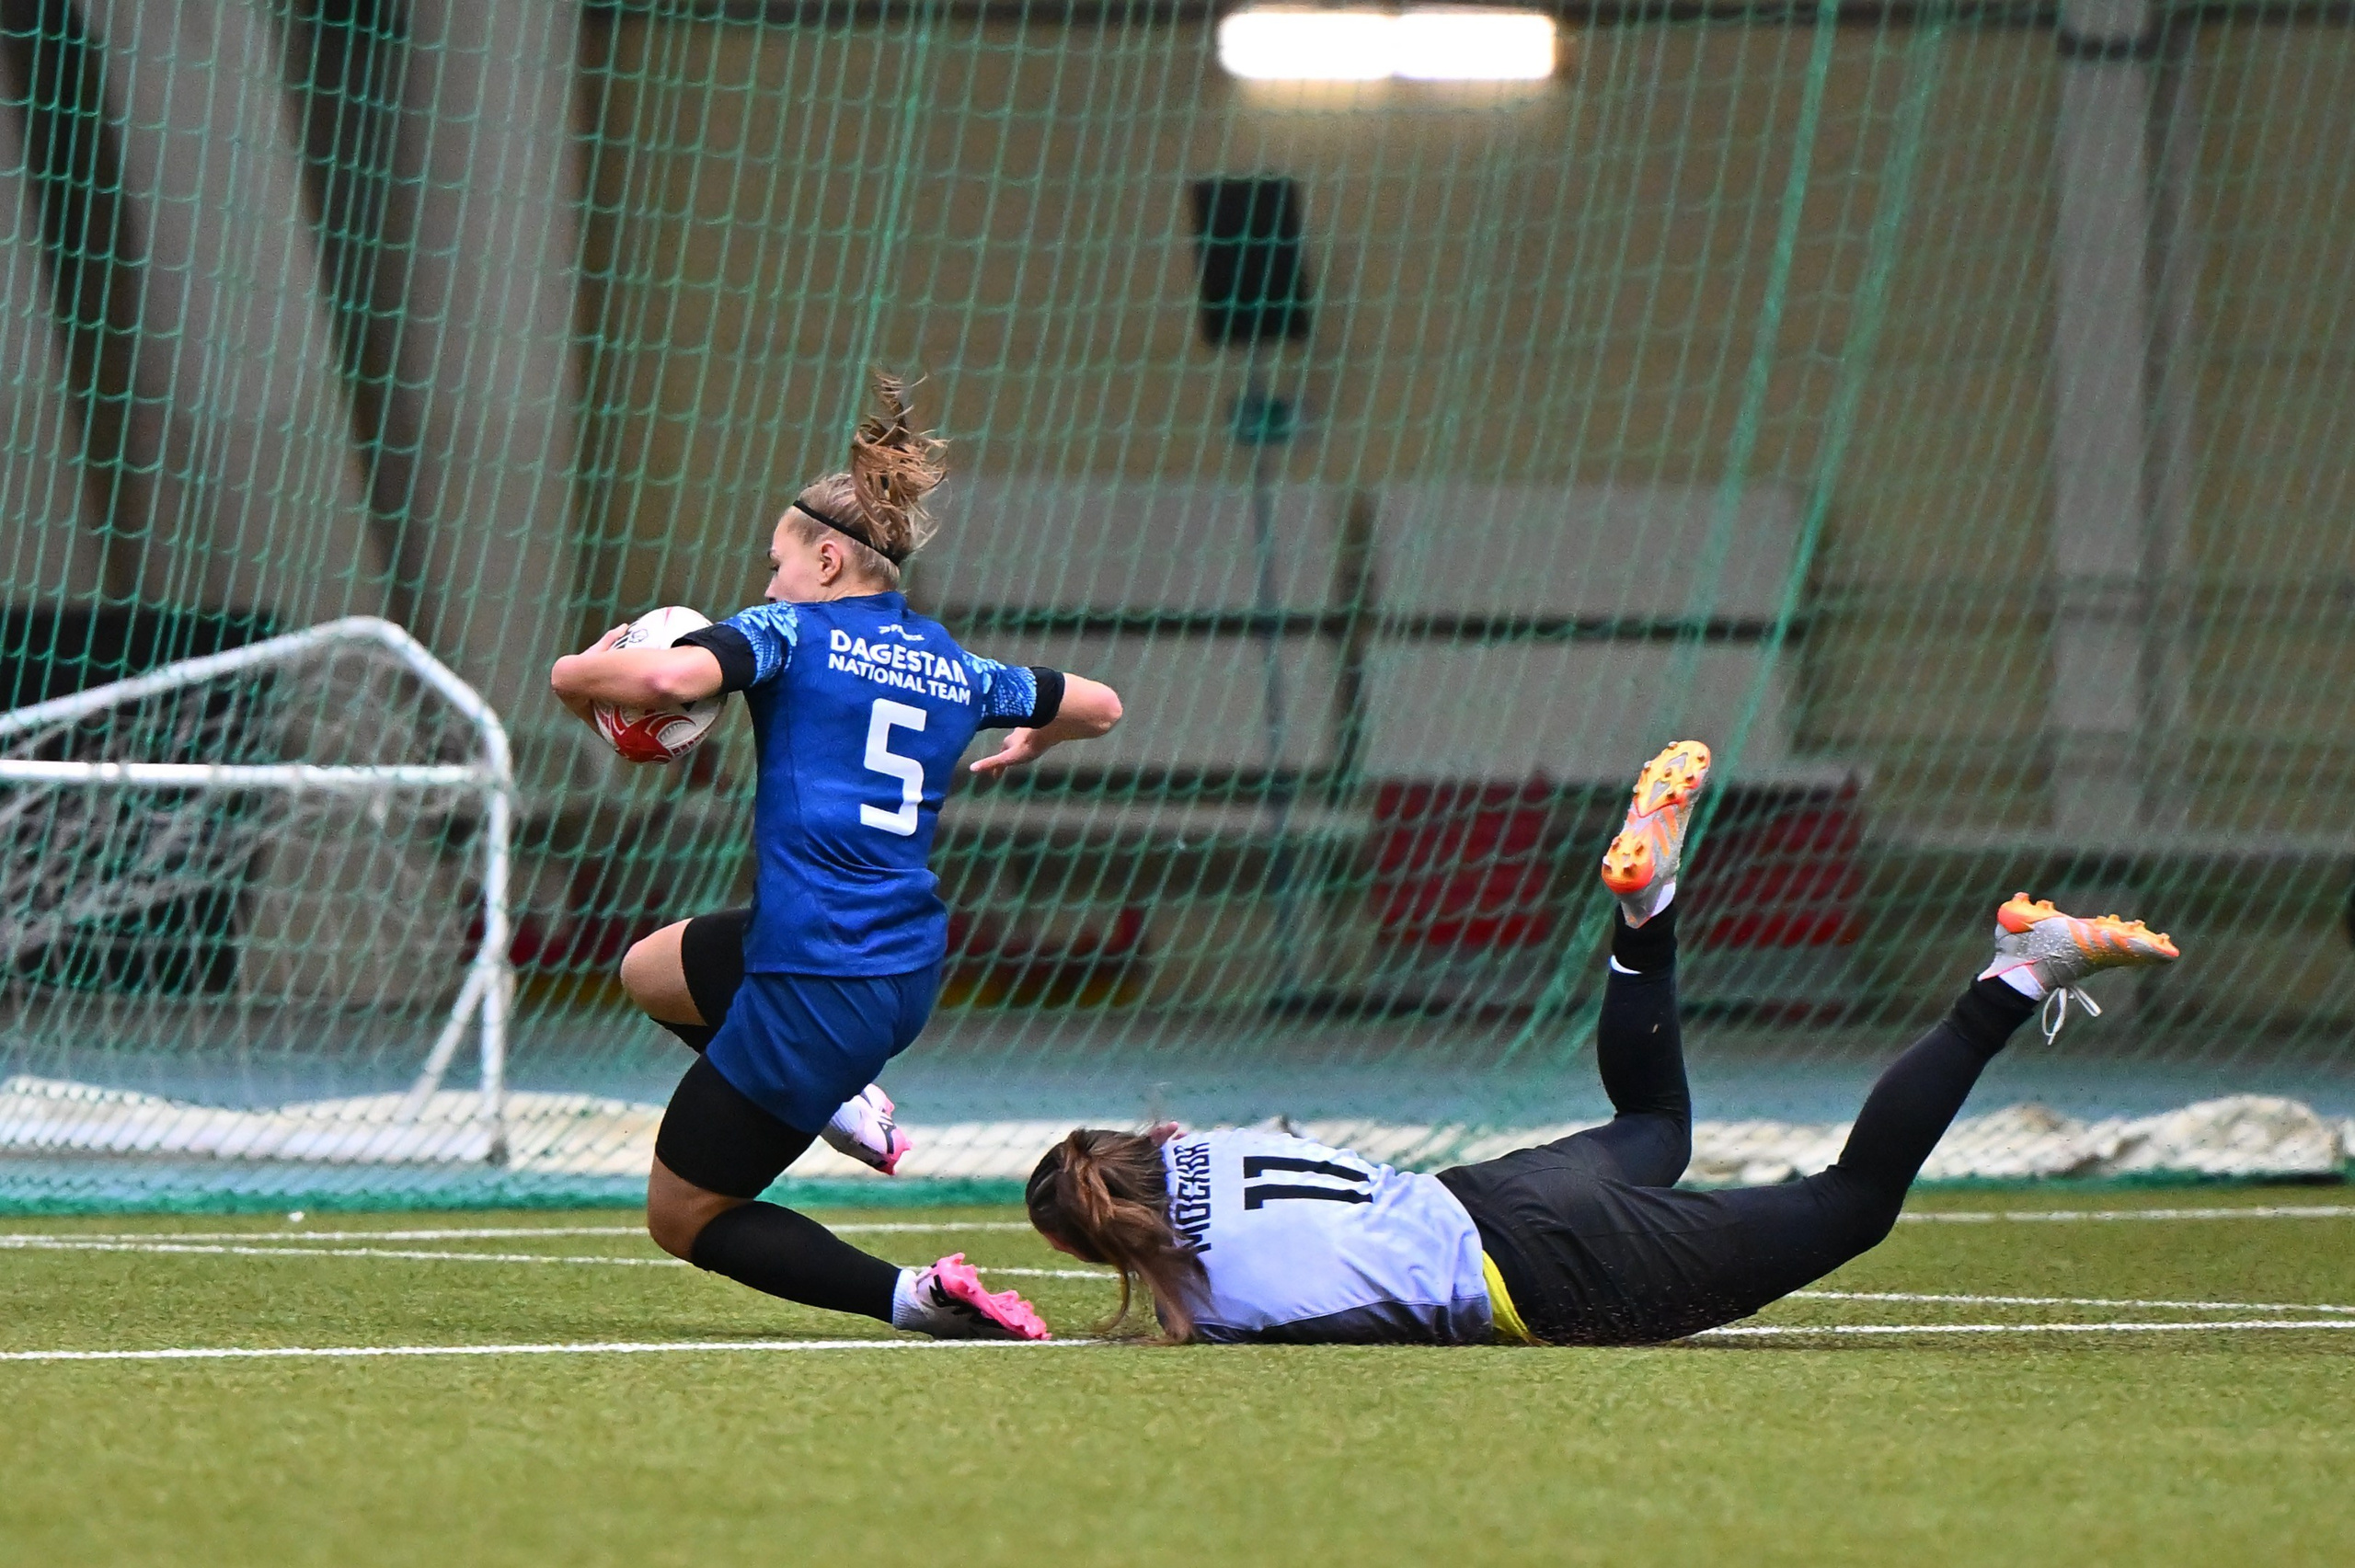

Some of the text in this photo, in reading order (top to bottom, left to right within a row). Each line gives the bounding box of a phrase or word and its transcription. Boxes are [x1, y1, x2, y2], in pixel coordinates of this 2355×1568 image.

[829, 654, 971, 706] NATIONAL TEAM
[830, 629, 969, 685] DAGESTAN
[860, 697, 927, 837] 5
[1243, 1155, 1373, 1211] 11
